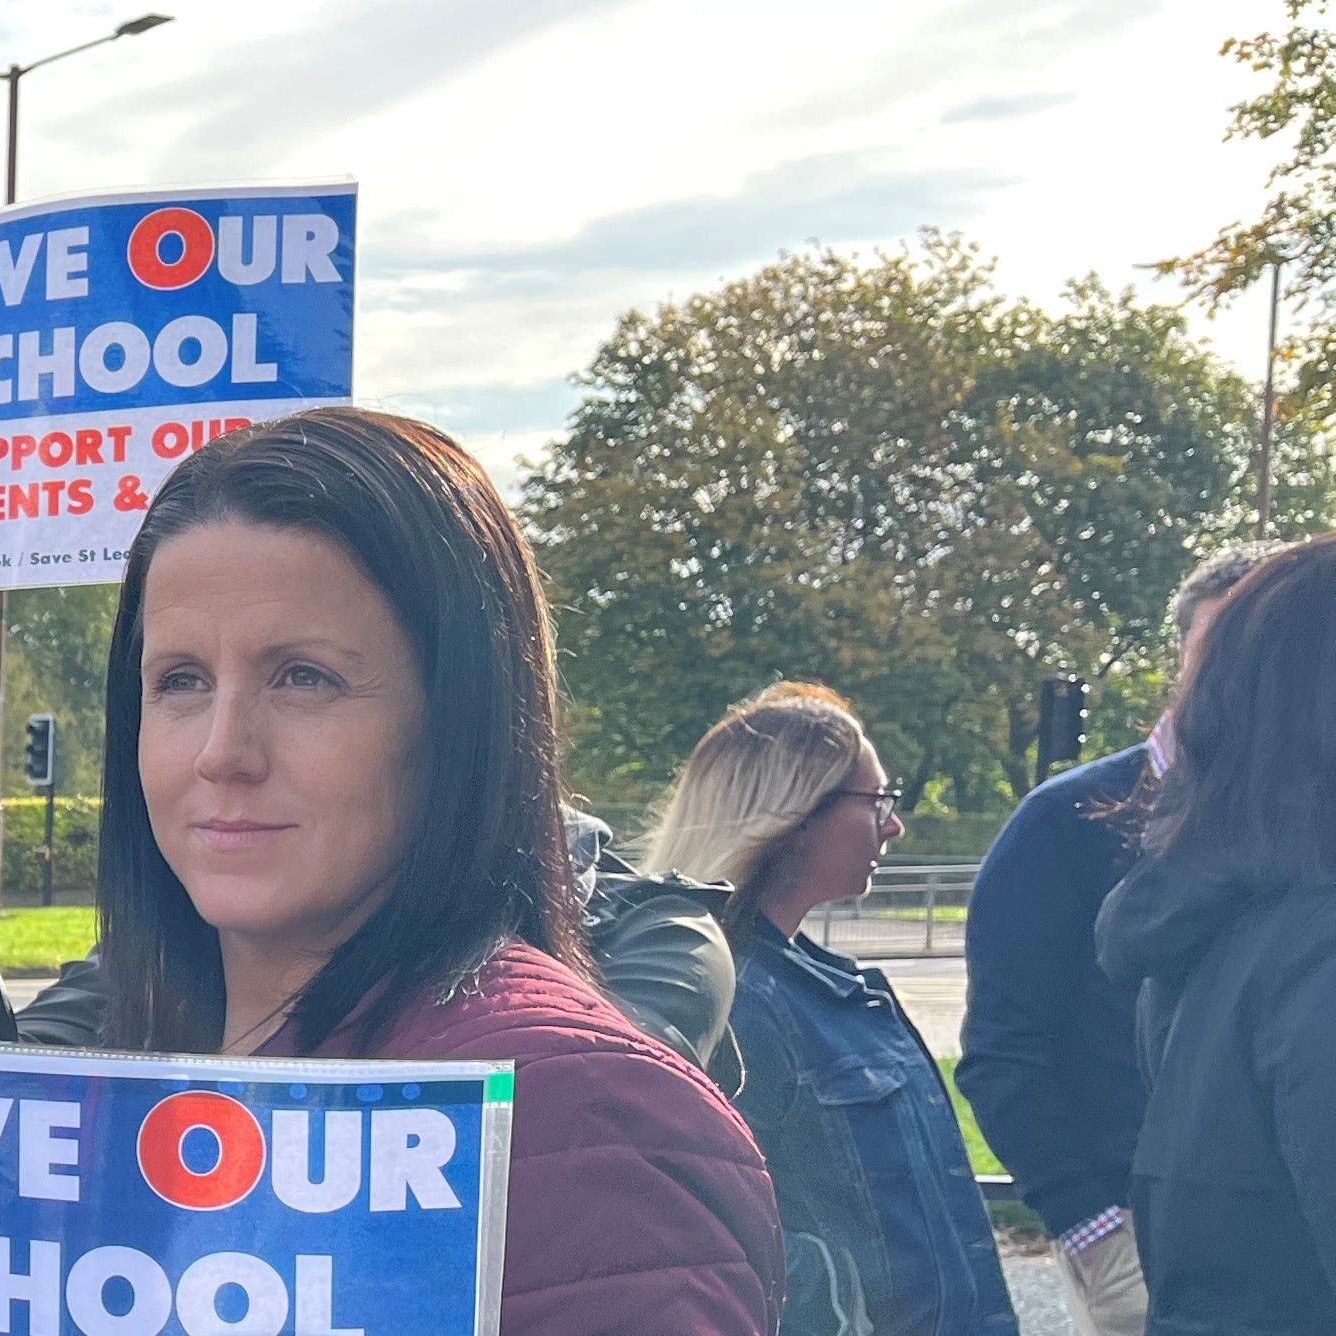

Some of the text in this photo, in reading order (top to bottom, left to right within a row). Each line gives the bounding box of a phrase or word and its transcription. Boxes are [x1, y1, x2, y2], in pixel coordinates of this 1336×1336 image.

[127, 207, 343, 291] OUR
[113, 474, 149, 512] &
[30, 551, 72, 565] Save
[78, 549, 96, 562] St
[136, 1089, 461, 1213] OUR
